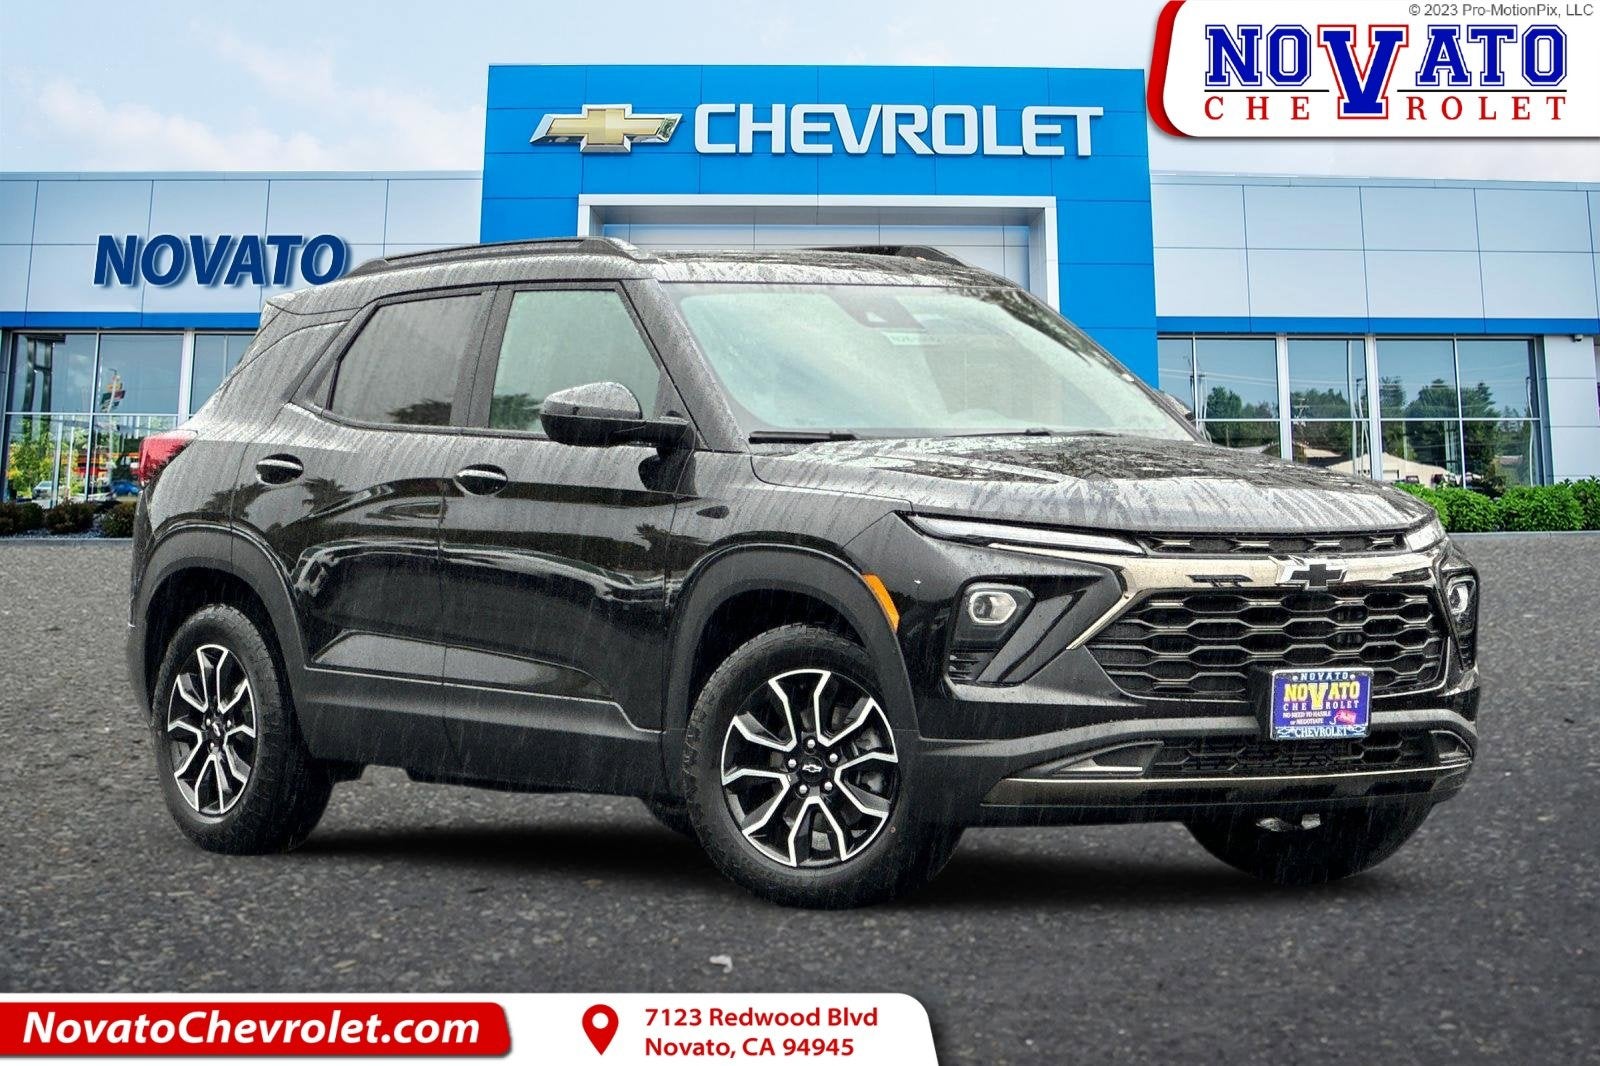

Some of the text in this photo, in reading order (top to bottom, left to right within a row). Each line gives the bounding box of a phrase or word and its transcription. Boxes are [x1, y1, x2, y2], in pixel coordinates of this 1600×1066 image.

[695, 103, 1103, 157] CHEVROLET
[93, 233, 349, 286] NOVATO
[1300, 672, 1349, 681] NOVATO
[1283, 681, 1360, 710] NOVATO
[1294, 725, 1348, 738] CHEVROLET
